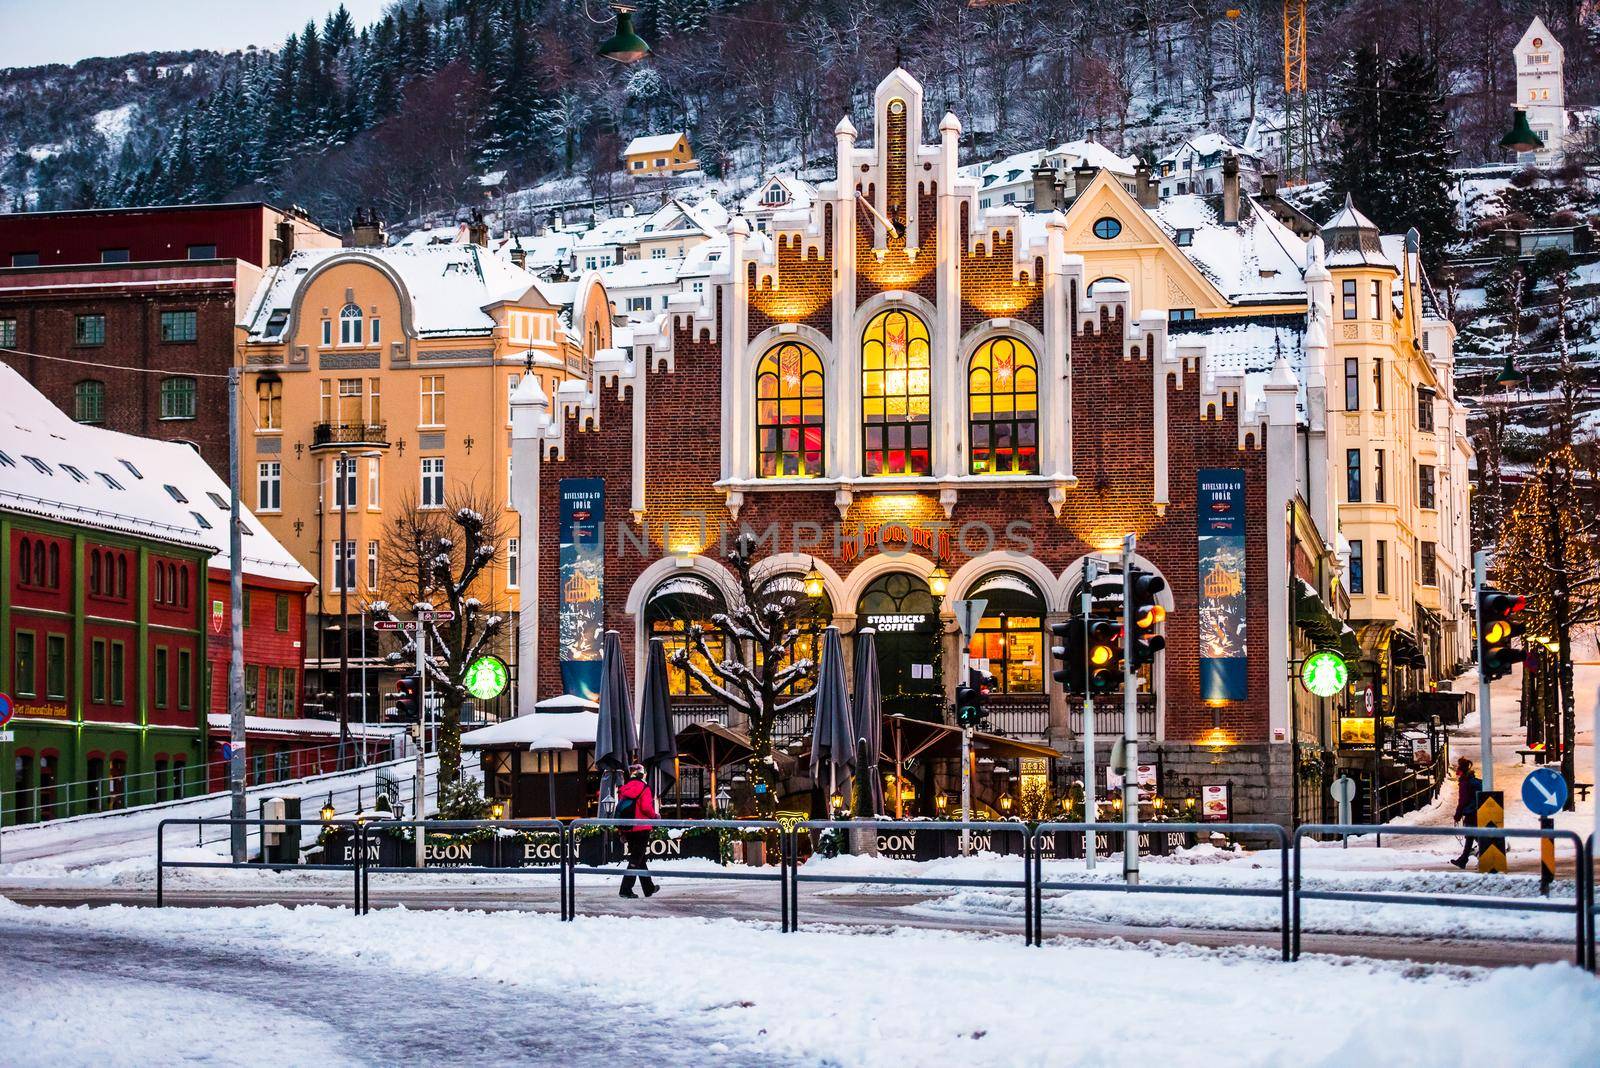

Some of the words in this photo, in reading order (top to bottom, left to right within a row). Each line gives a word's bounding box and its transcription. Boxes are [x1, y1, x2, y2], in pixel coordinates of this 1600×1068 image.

[867, 615, 925, 624] STARBUCKS
[878, 623, 915, 632] COFFEE
[877, 835, 916, 851] GON
[1082, 835, 1108, 850] EON
[1167, 833, 1186, 846] EGON
[423, 844, 473, 860] EGON
